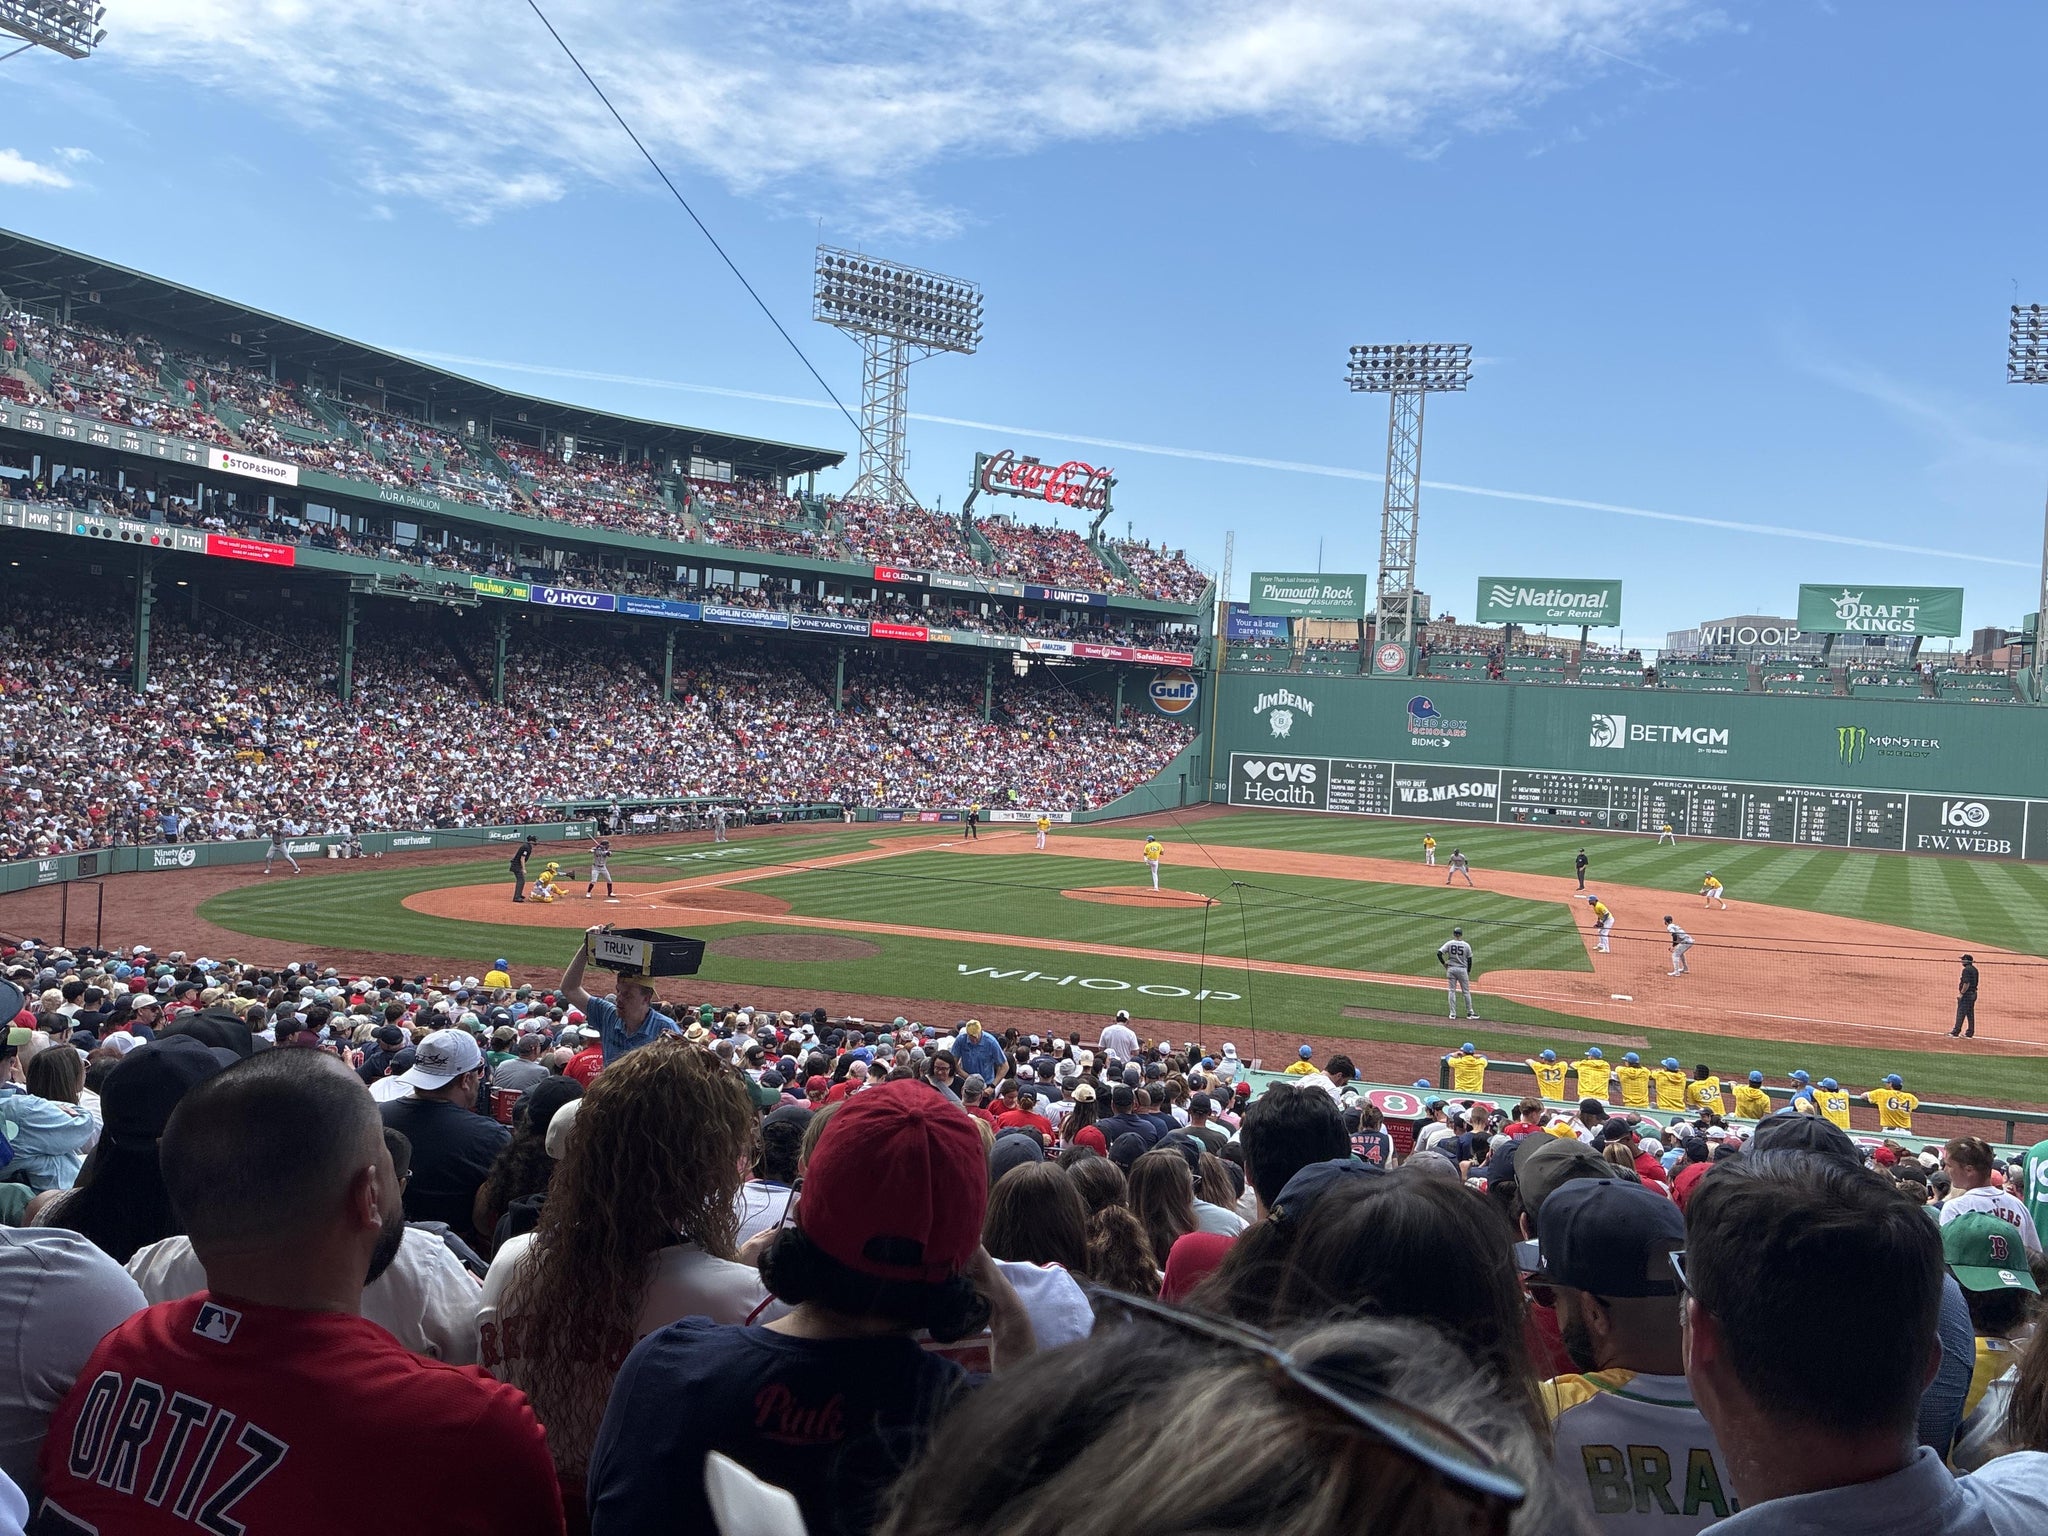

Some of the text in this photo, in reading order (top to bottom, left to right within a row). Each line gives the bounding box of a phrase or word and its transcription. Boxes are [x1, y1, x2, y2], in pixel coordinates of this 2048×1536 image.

[22, 418, 43, 431] .253
[57, 426, 76, 437] .313
[89, 432, 110, 444] .402
[122, 439, 139, 450] .715
[186, 452, 197, 461] 28
[229, 458, 287, 477] STOP&SHOP
[379, 489, 441, 512] AURA PAVILION
[7, 516, 14, 525] 5
[28, 513, 50, 525] MVR
[56, 512, 63, 522] 4
[84, 516, 105, 527] BALL
[56, 522, 62, 532] 3
[118, 521, 146, 533] STRIKE
[154, 527, 170, 537] OUT
[181, 535, 202, 549] 7TH
[892, 572, 910, 581] OLED
[937, 577, 952, 585] PITCH
[952, 580, 969, 588] BREAK
[473, 580, 527, 598] SULLIVAN TIRE
[1262, 584, 1354, 600] Plymouth Rock
[561, 592, 597, 606] HYCU
[1054, 591, 1089, 604] UNITED
[1516, 587, 1606, 608] National
[705, 607, 741, 618] COGHLIN
[741, 612, 788, 622] COMPANIES
[1546, 608, 1602, 618] Car Rental
[1835, 602, 1920, 620] DRAFT
[801, 619, 867, 632] VINEYARD VINES
[1236, 619, 1279, 629] Your all-star
[1845, 617, 1915, 632] KINGS
[1700, 626, 1800, 646] WHOOP
[1085, 647, 1101, 656] Ninety
[1136, 653, 1164, 662] Safelite
[1151, 682, 1194, 698] Gulf
[1253, 688, 1315, 717] JIM BEAM
[1413, 718, 1468, 729] RED SOX
[1412, 727, 1467, 737] SCHOLARS
[1630, 724, 1729, 746] BETMGM
[1411, 737, 1441, 747] BIDMC
[1869, 735, 1940, 749] MONSTER
[1878, 750, 1930, 758] ENERGY
[1266, 761, 1317, 783] CVS
[1528, 773, 1612, 784] FENWAY PARK
[1214, 782, 1227, 790] 310
[1652, 781, 1728, 791] AMERICAN LEAGUE
[1243, 782, 1316, 804] Health
[1785, 789, 1826, 797] NATIONAL
[1329, 797, 1356, 805] BALTIMORE
[1456, 800, 1477, 808] SINCE
[1016, 812, 1032, 820] TRULY
[1555, 809, 1577, 817] STRIKE
[393, 836, 432, 846] smartwater
[501, 832, 521, 840] TICKET
[287, 841, 321, 854] Franklin
[1917, 834, 2011, 854] F.W. WEBB
[154, 848, 179, 858] Ninety
[153, 856, 178, 867] Nine
[603, 940, 634, 957] TRULY
[1450, 944, 1465, 956] 85
[958, 964, 1242, 1001] WHOOP
[1544, 1068, 1562, 1082] 12
[1699, 1085, 1720, 1101] 32
[1383, 1095, 1409, 1112] 8
[1827, 1097, 1847, 1112] 85
[1887, 1096, 1911, 1113] 64
[1988, 1234, 2009, 1261] B
[68, 1370, 291, 1536] ORTIZ
[1581, 1444, 1741, 1518] BRA
